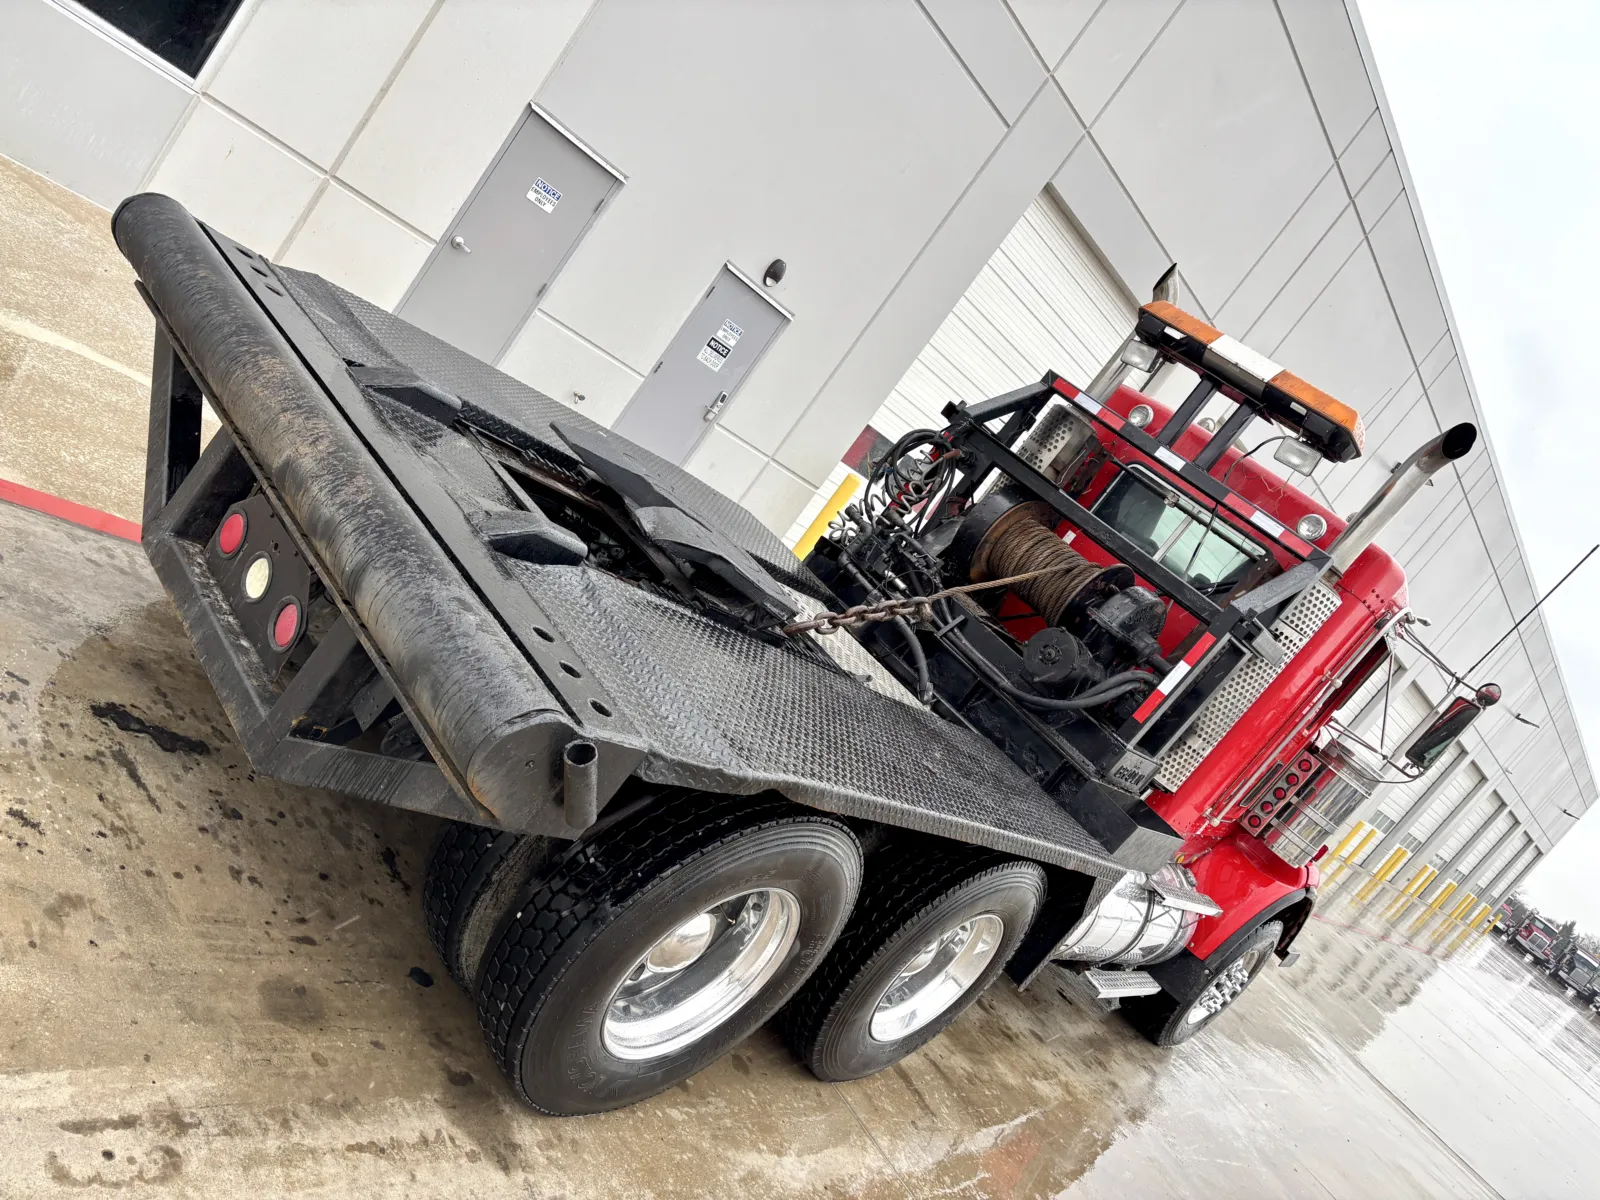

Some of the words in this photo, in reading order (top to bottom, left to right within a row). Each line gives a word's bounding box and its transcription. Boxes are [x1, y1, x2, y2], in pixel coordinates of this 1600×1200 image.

[531, 186, 557, 207] EMPLOYEES
[536, 179, 561, 201] NOTICE
[534, 196, 546, 207] ONLY
[708, 340, 729, 356] NOTICE
